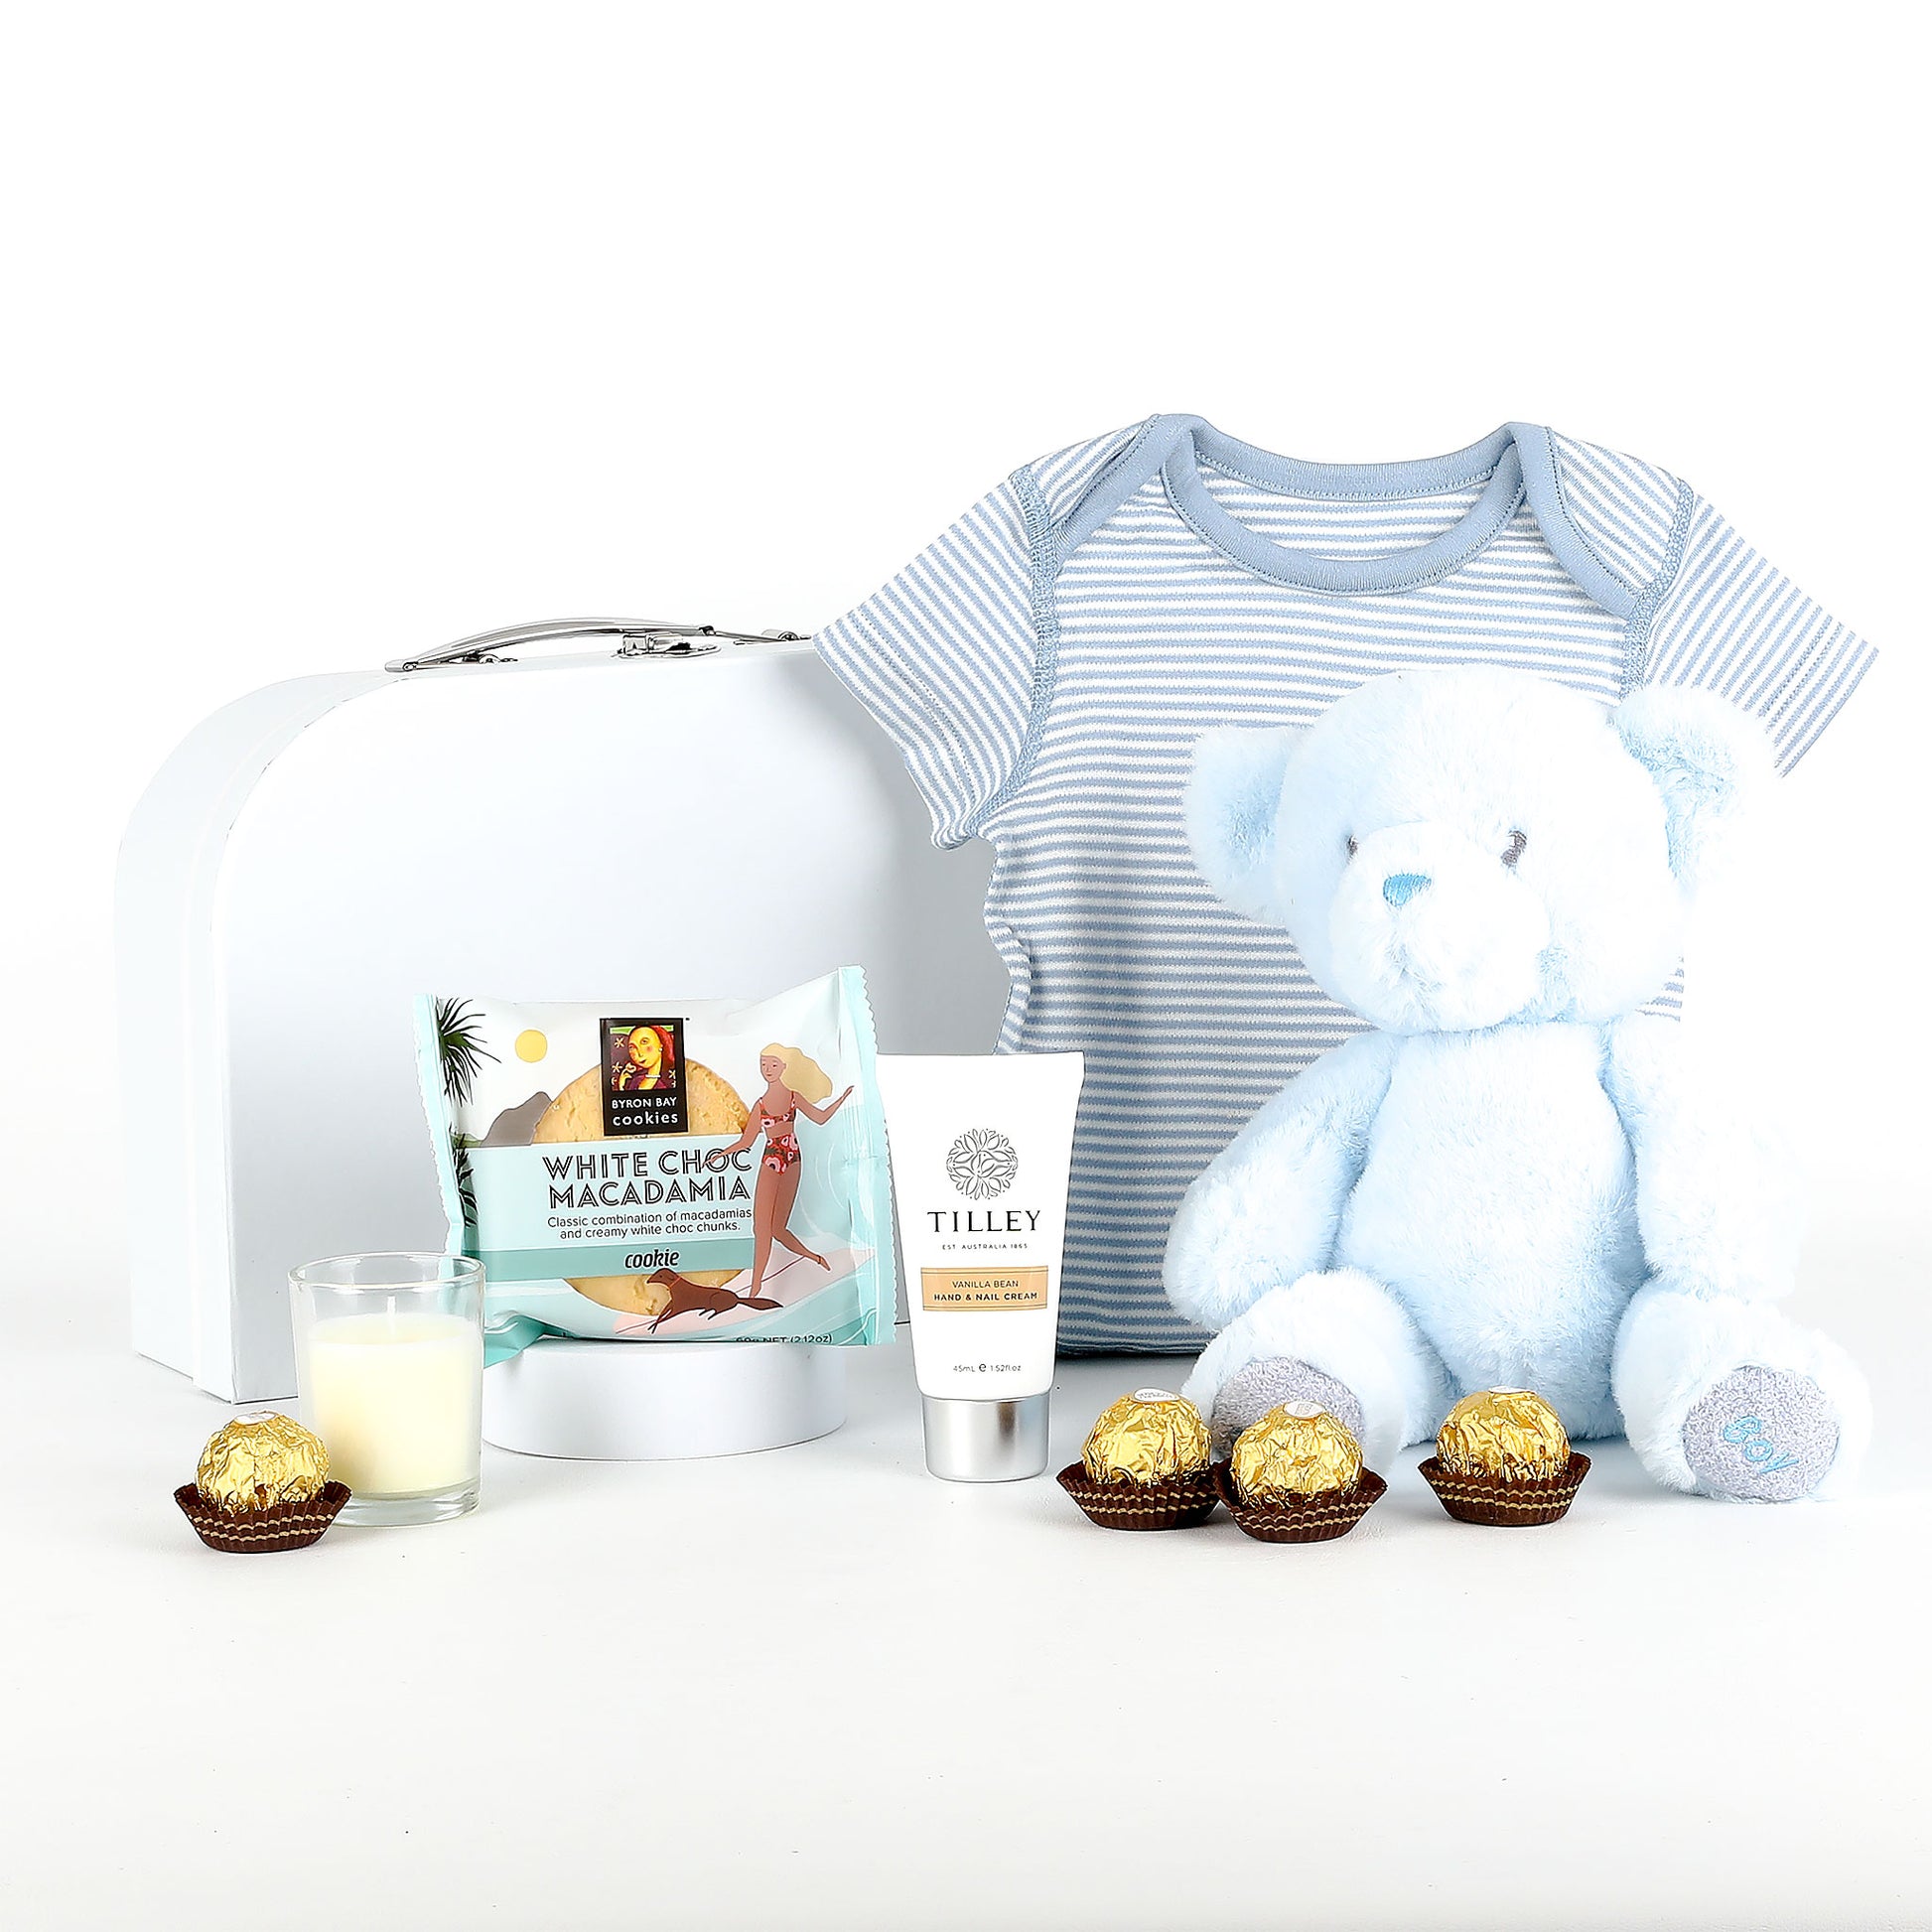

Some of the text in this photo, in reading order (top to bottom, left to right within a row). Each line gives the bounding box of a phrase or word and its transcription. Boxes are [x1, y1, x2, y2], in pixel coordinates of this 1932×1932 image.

[612, 1097, 677, 1109] BYRON BAY
[613, 1111, 678, 1126] cookies
[542, 1148, 753, 1180] WHITE CHOC
[549, 1175, 751, 1209] MACADAMIA
[547, 1208, 753, 1228] Classic combination of macadamias
[926, 1210, 1040, 1232] TILLEY
[560, 1221, 741, 1240] and creamy white choc chunks.
[624, 1248, 680, 1269] cookie
